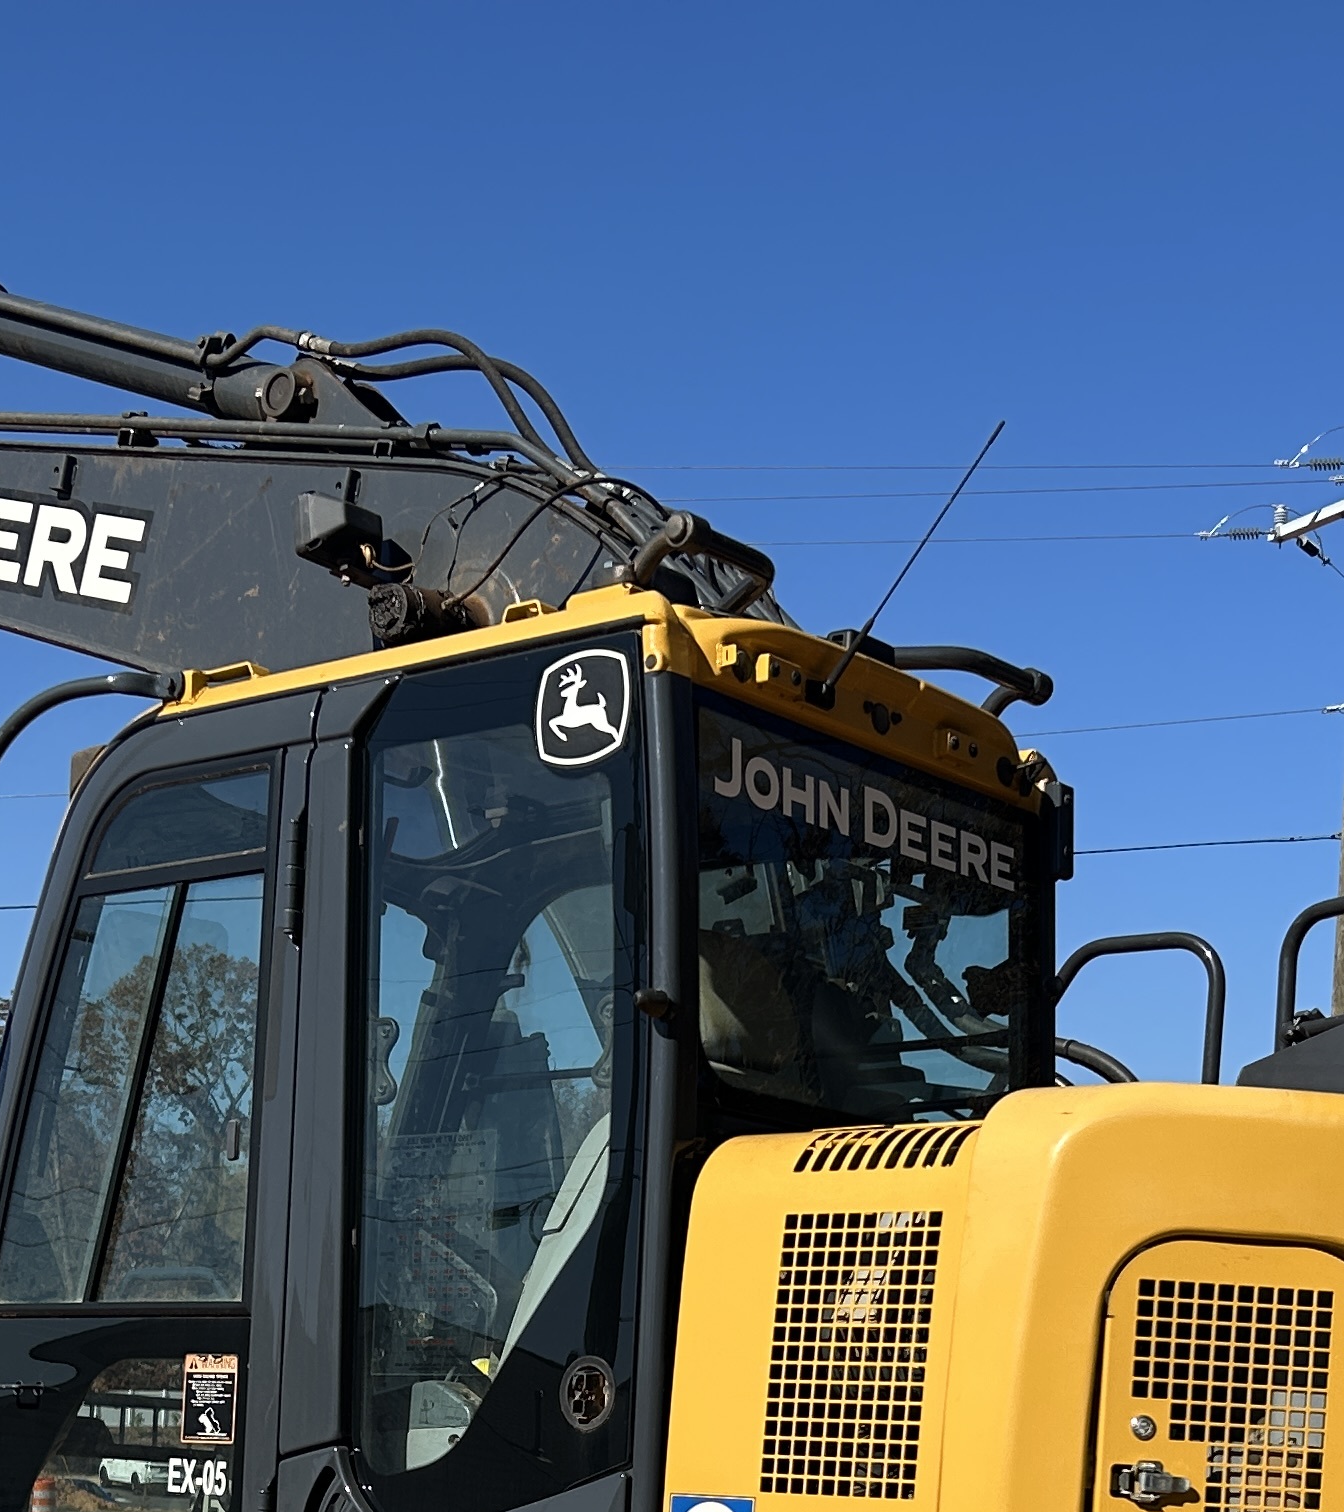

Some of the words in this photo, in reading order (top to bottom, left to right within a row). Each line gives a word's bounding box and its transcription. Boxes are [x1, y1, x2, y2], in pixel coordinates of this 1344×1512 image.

[713, 737, 850, 837] JOHN
[863, 786, 1017, 892] DEERE
[167, 1457, 227, 1496] EX-05
